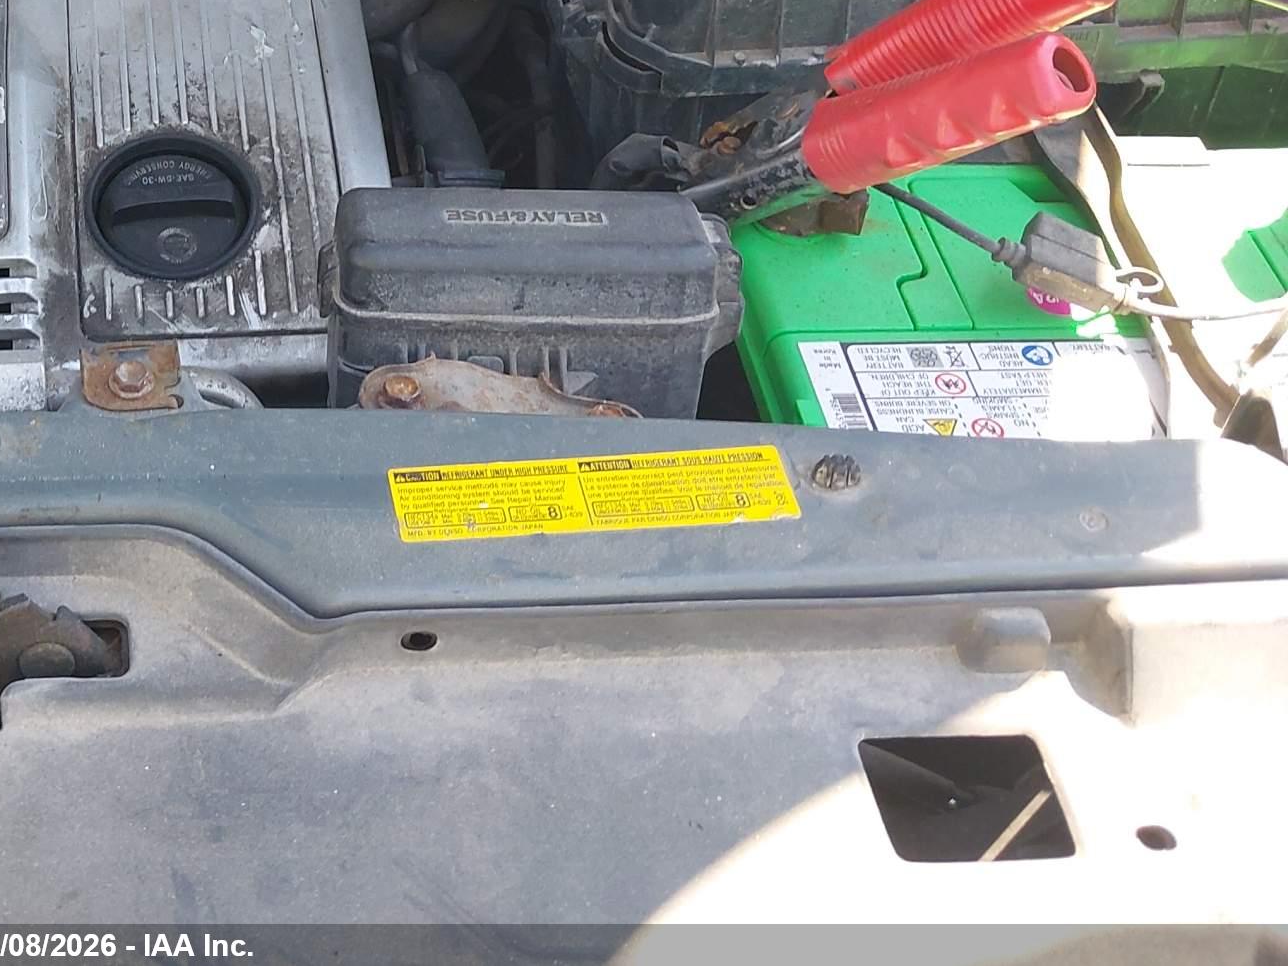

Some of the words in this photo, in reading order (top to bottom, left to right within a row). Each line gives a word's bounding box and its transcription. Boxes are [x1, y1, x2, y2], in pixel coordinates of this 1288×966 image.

[446, 209, 605, 224] RELAY&FUSE
[590, 460, 630, 471] ATTENTION
[727, 452, 764, 462] PRESSION
[514, 466, 532, 476] HIGH
[533, 465, 568, 475] PRESSURE
[735, 494, 747, 507] 8
[548, 506, 559, 519] 8
